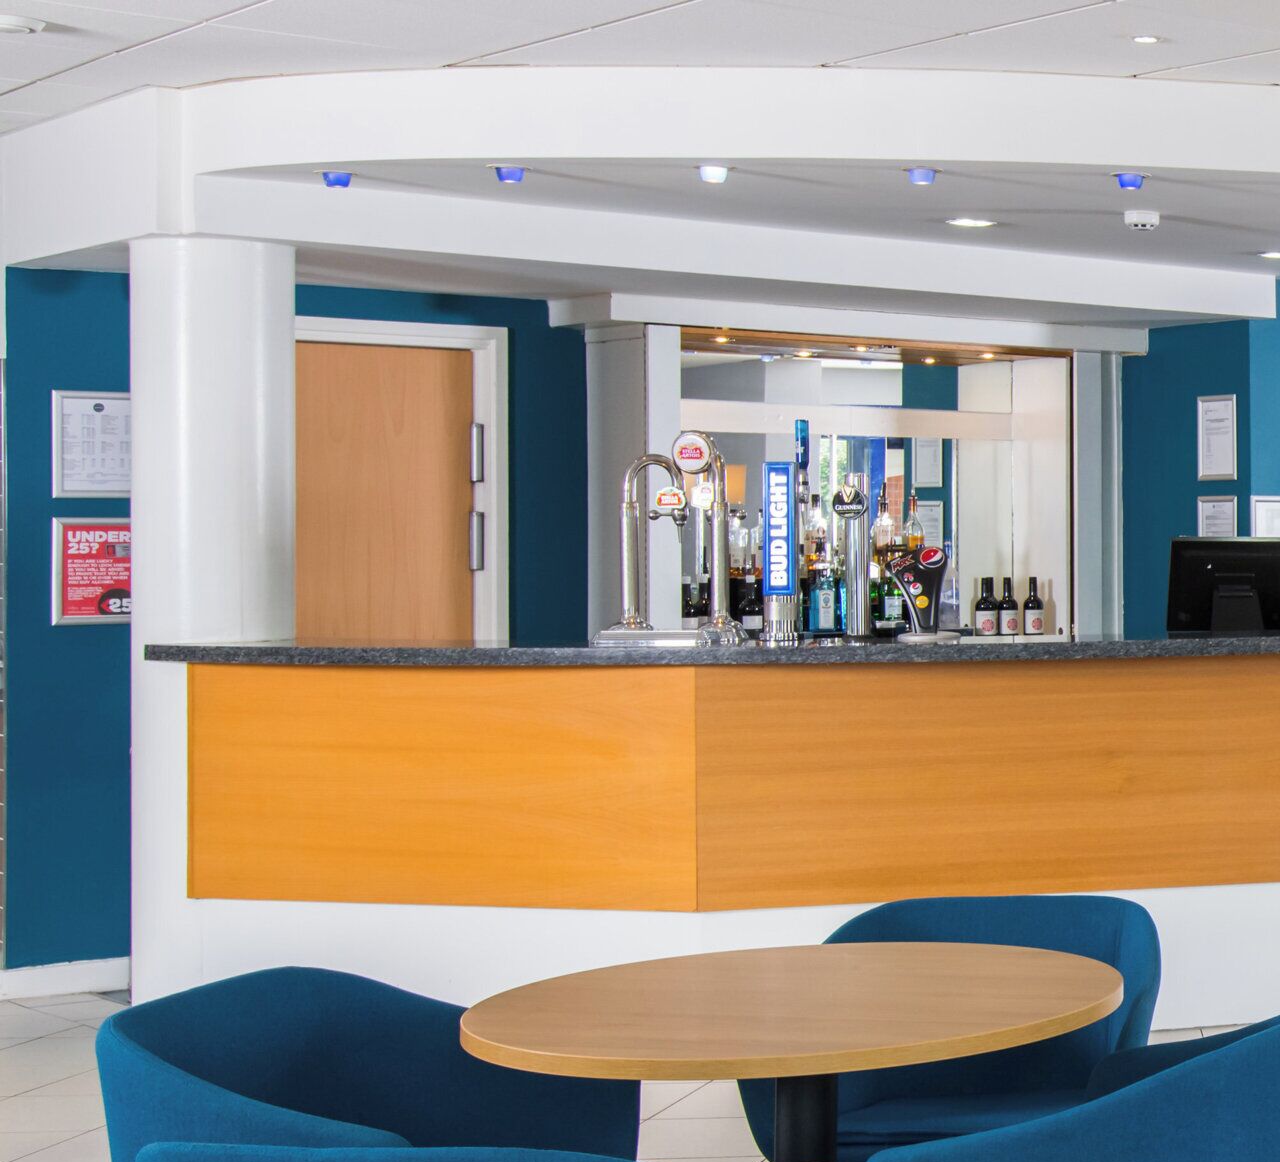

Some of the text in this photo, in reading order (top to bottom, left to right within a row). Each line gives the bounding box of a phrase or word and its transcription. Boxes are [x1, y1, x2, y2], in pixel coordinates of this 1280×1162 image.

[770, 472, 788, 586] BUD LIGHT
[67, 531, 131, 543] UNDER
[67, 543, 100, 554] 25?
[109, 598, 131, 613] 25
